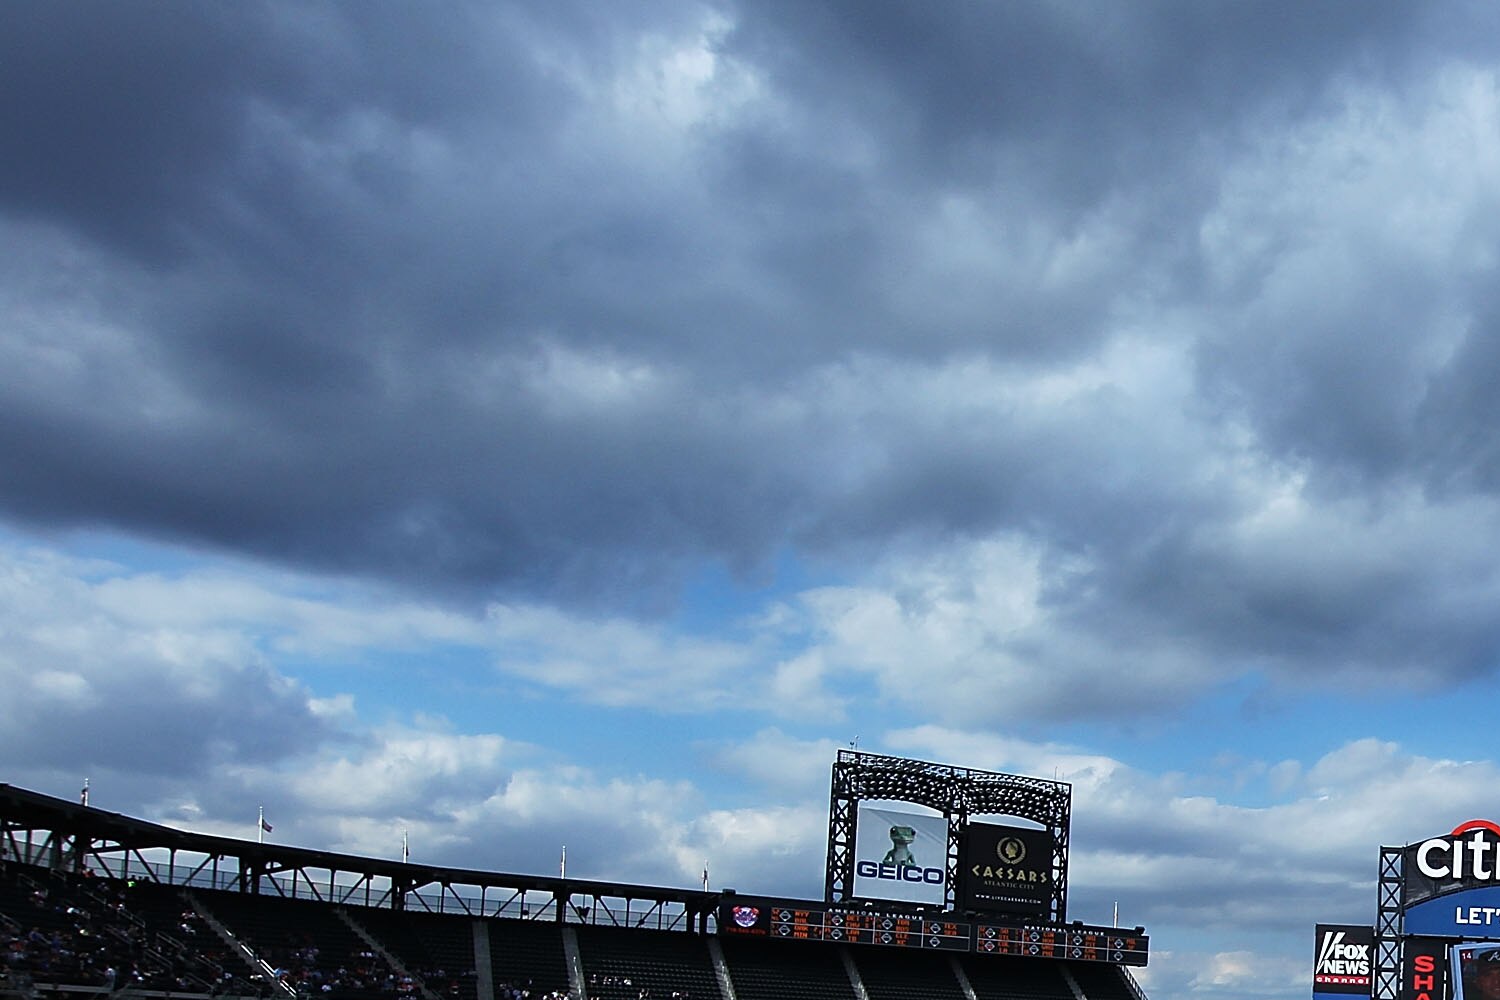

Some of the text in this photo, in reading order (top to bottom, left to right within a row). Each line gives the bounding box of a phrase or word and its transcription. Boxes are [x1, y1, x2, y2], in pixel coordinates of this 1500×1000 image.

[857, 861, 944, 884] GEICO
[972, 865, 1048, 883] CAESARS
[984, 880, 1017, 889] ATLANTIC
[828, 908, 924, 920] AMERICAN LEAGUE
[1024, 925, 1066, 933] NATIONAL
[1334, 944, 1369, 960] FOX
[1323, 961, 1370, 976] NEWS
[1316, 976, 1370, 984] channel
